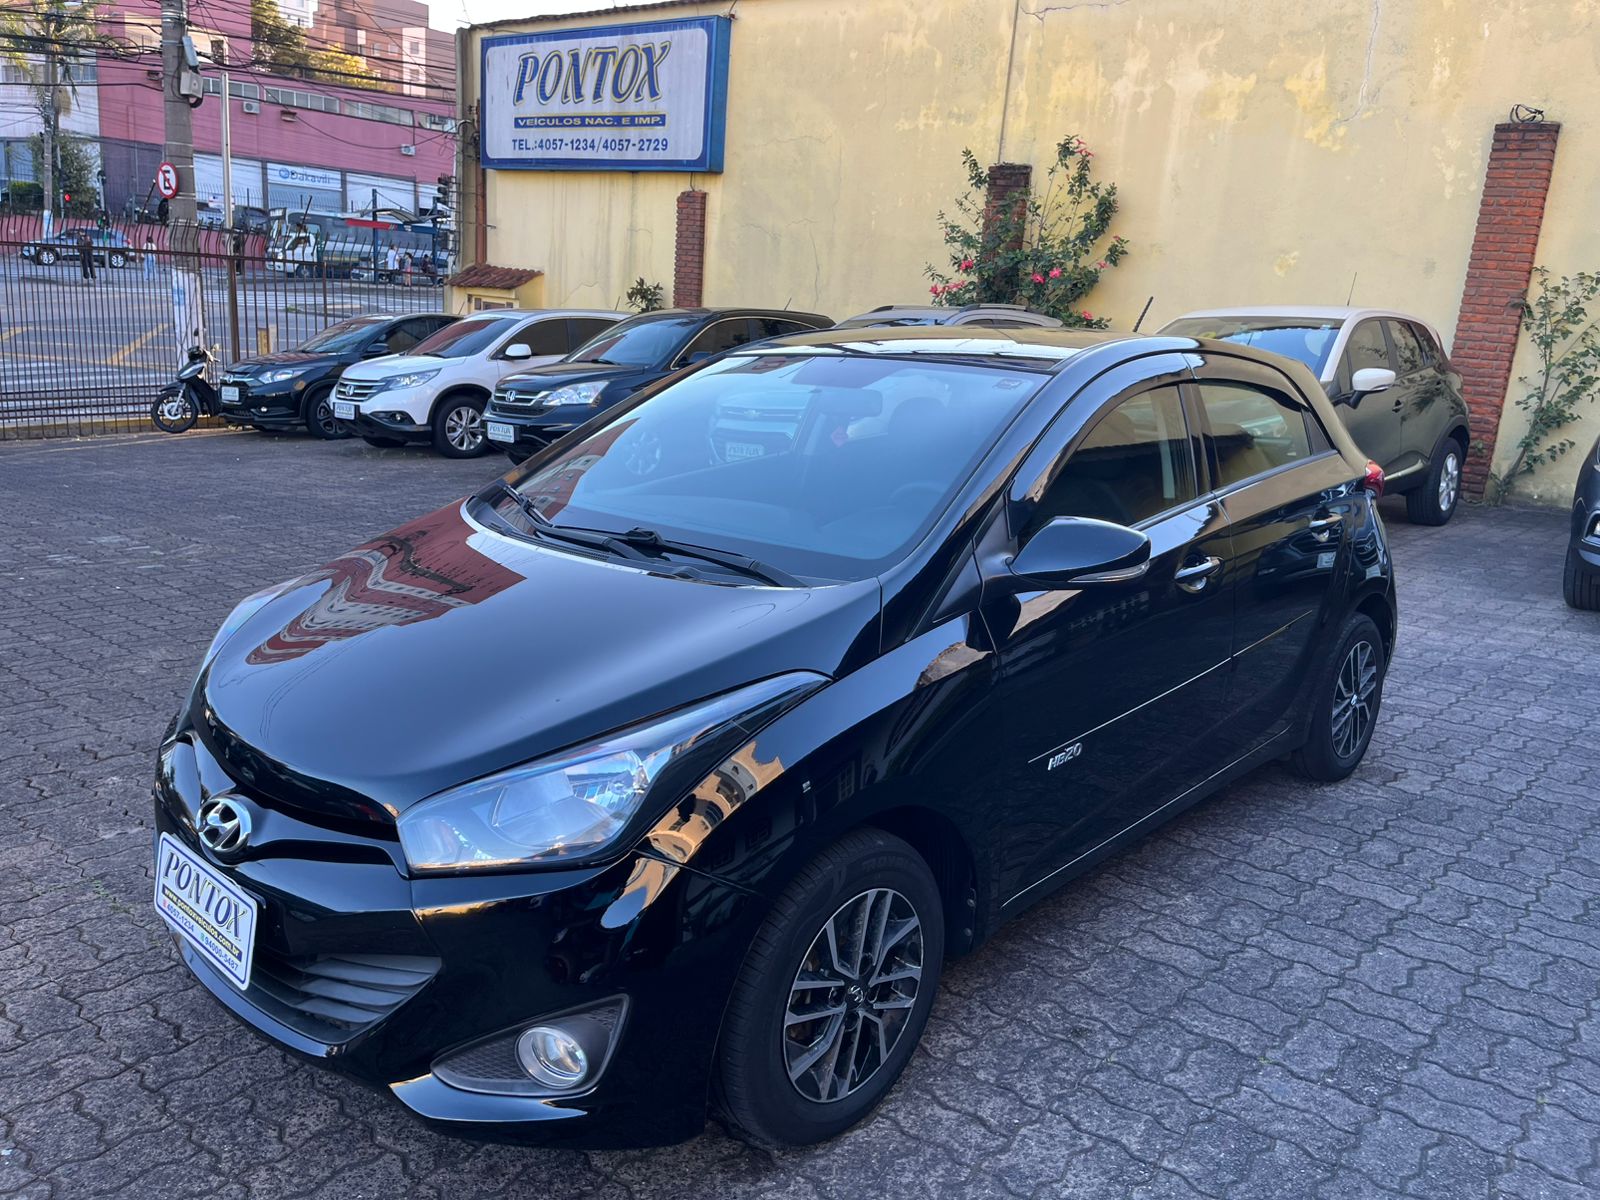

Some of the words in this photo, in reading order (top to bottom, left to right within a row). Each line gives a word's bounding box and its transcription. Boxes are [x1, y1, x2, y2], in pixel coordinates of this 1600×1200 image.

[513, 41, 672, 106] PONTOX
[585, 117, 617, 125] NAC.
[622, 116, 631, 124] E
[635, 116, 662, 124] IMP.
[1047, 742, 1083, 771] HB20
[163, 849, 248, 941] PONTOX
